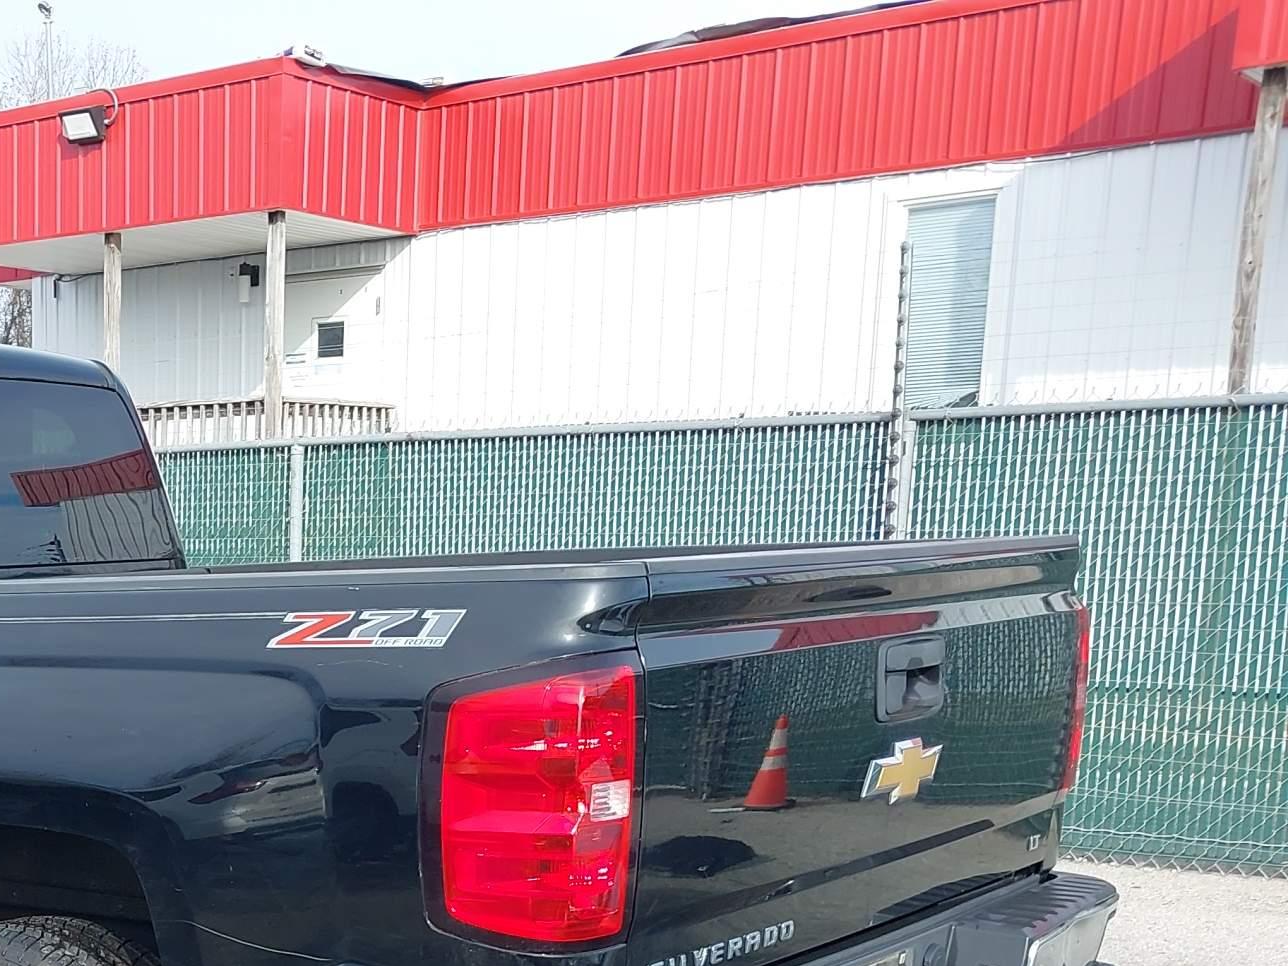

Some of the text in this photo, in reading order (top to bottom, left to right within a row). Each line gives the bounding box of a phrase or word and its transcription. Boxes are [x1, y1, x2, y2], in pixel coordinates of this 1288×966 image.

[266, 609, 467, 648] Z71
[375, 638, 444, 646] OFF ROAD
